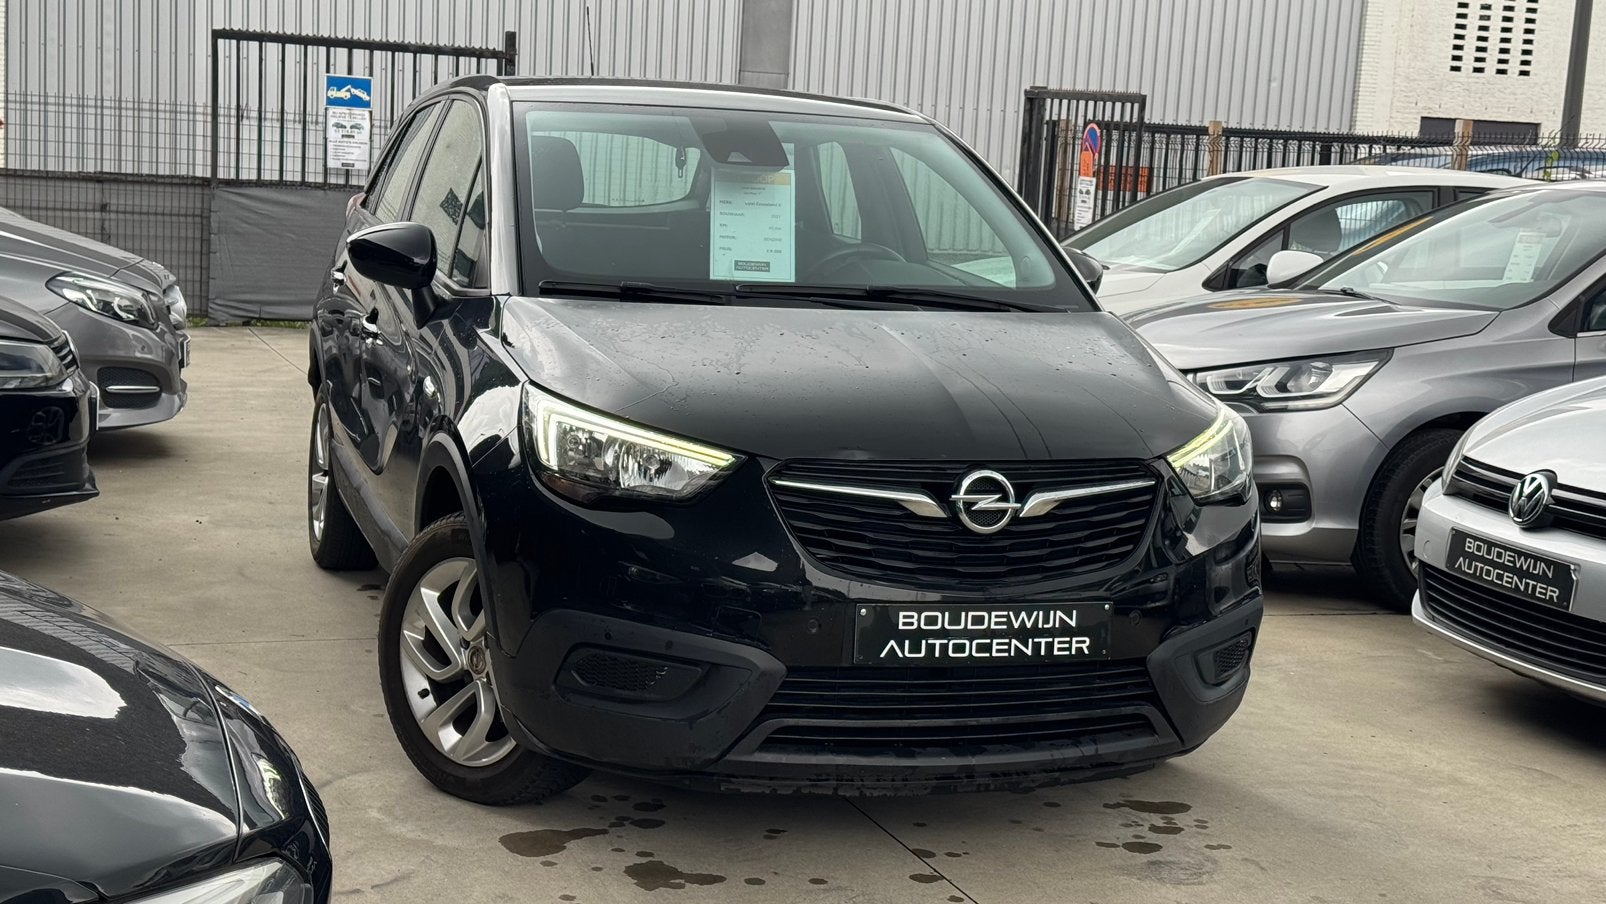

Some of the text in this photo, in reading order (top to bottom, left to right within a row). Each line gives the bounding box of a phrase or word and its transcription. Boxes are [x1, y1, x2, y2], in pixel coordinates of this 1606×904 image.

[1464, 538, 1554, 579] BOUDEWIJN
[1455, 556, 1559, 602] AUTOCENTER
[897, 609, 1077, 630] BOUDEWIJN
[879, 636, 1091, 658] AUTOCENTER
